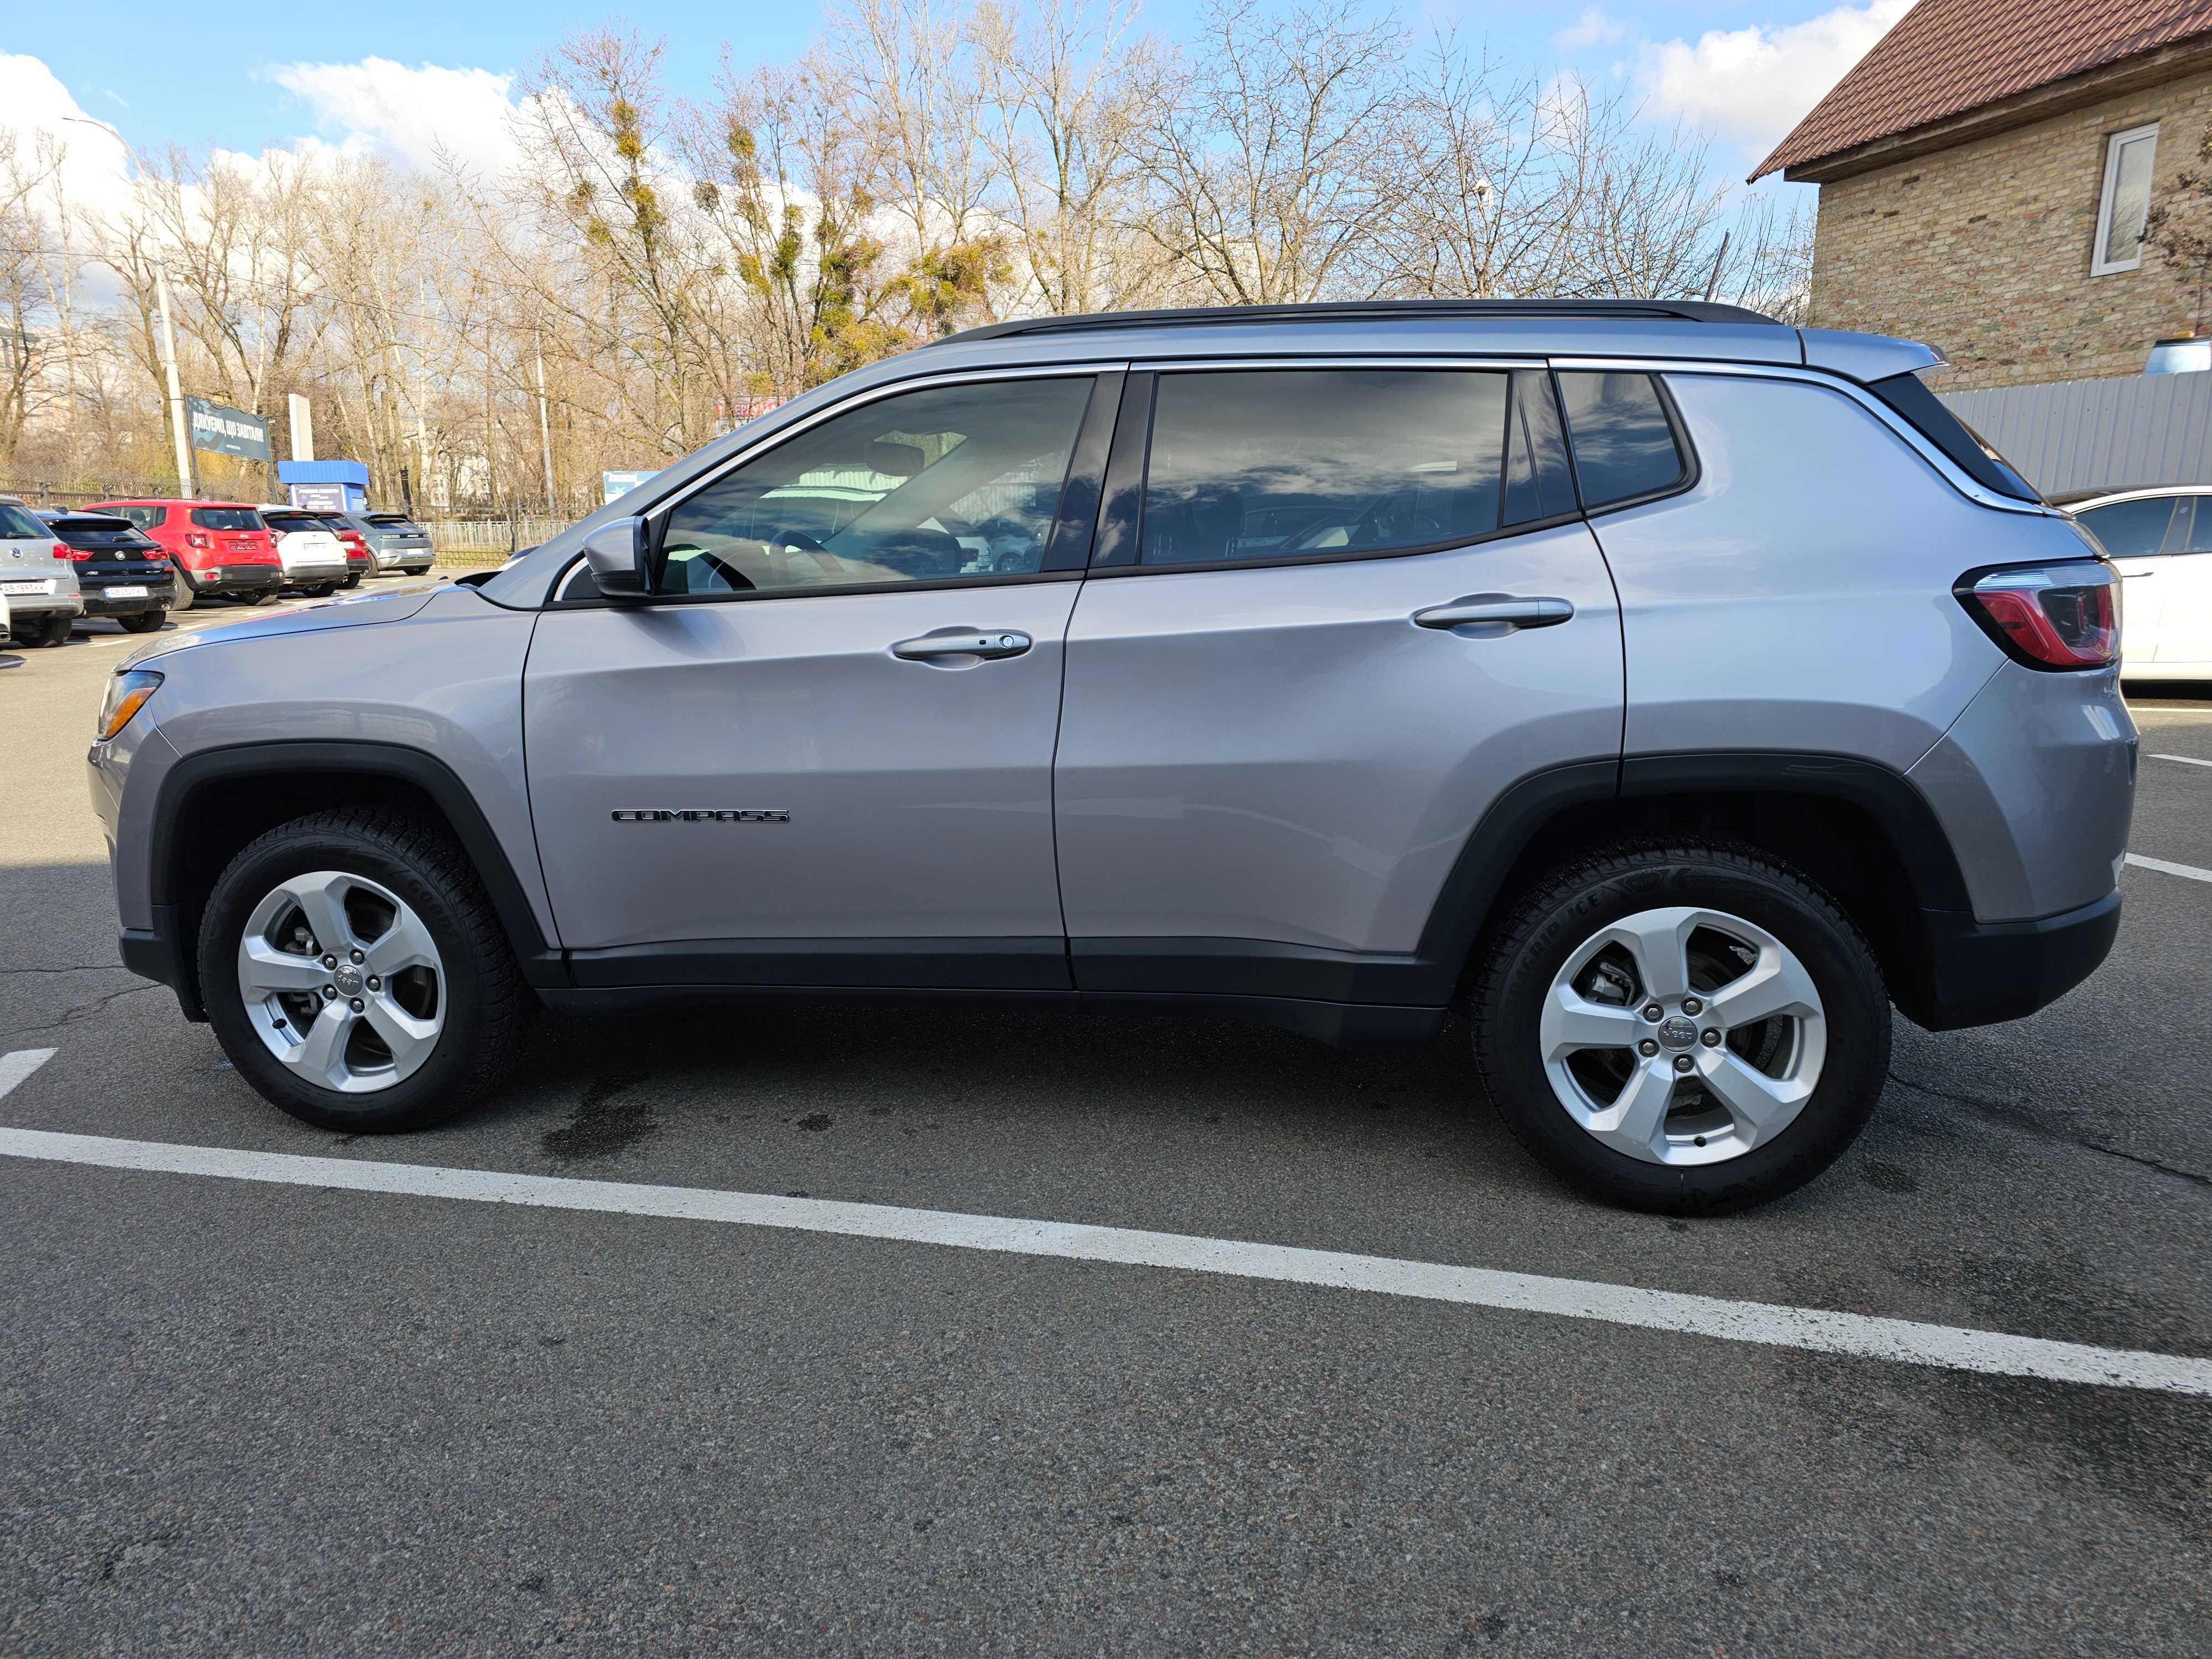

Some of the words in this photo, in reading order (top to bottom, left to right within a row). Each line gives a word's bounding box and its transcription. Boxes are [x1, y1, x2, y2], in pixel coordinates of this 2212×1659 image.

[194, 411, 227, 437] ДЯКУЄМО,
[226, 420, 237, 439] ЩО
[236, 422, 264, 442] ЗАВІТАЛИ!
[611, 809, 790, 822] COMPASS
